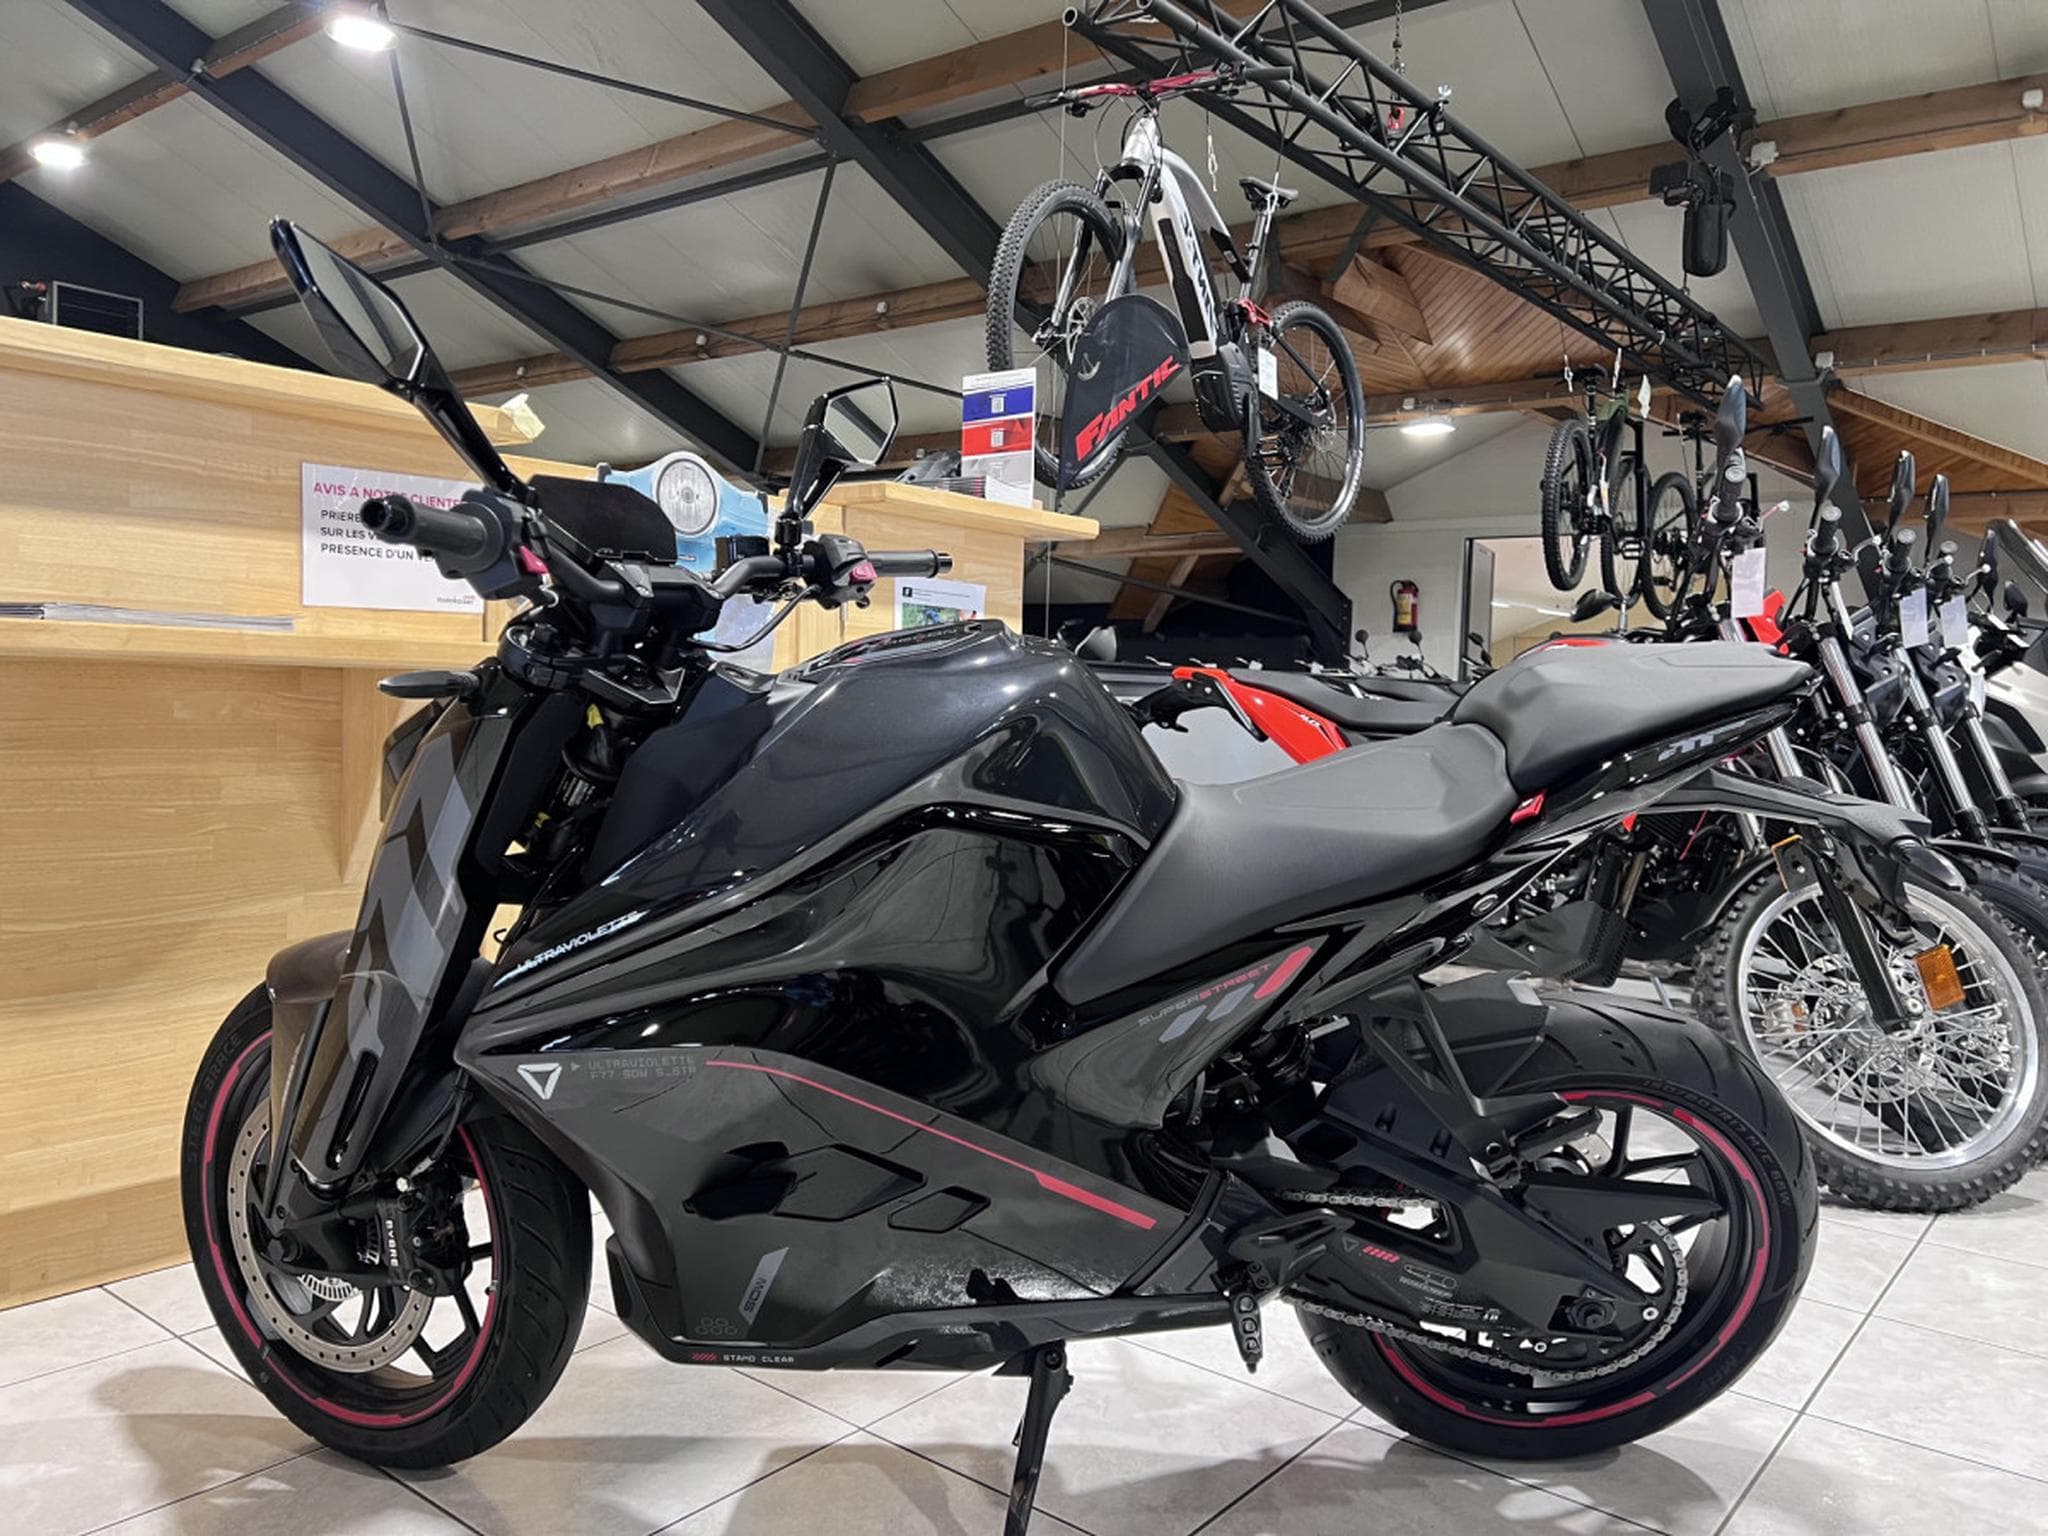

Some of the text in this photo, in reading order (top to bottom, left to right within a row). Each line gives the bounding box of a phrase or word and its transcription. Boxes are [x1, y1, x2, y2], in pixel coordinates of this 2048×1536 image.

[1075, 355, 1182, 462] FANTIC
[313, 482, 346, 496] AVIS
[349, 487, 359, 497] A
[320, 527, 344, 537] SUR
[345, 529, 366, 540] LES
[320, 543, 383, 558] PRESENCE
[385, 549, 414, 560] D'UN
